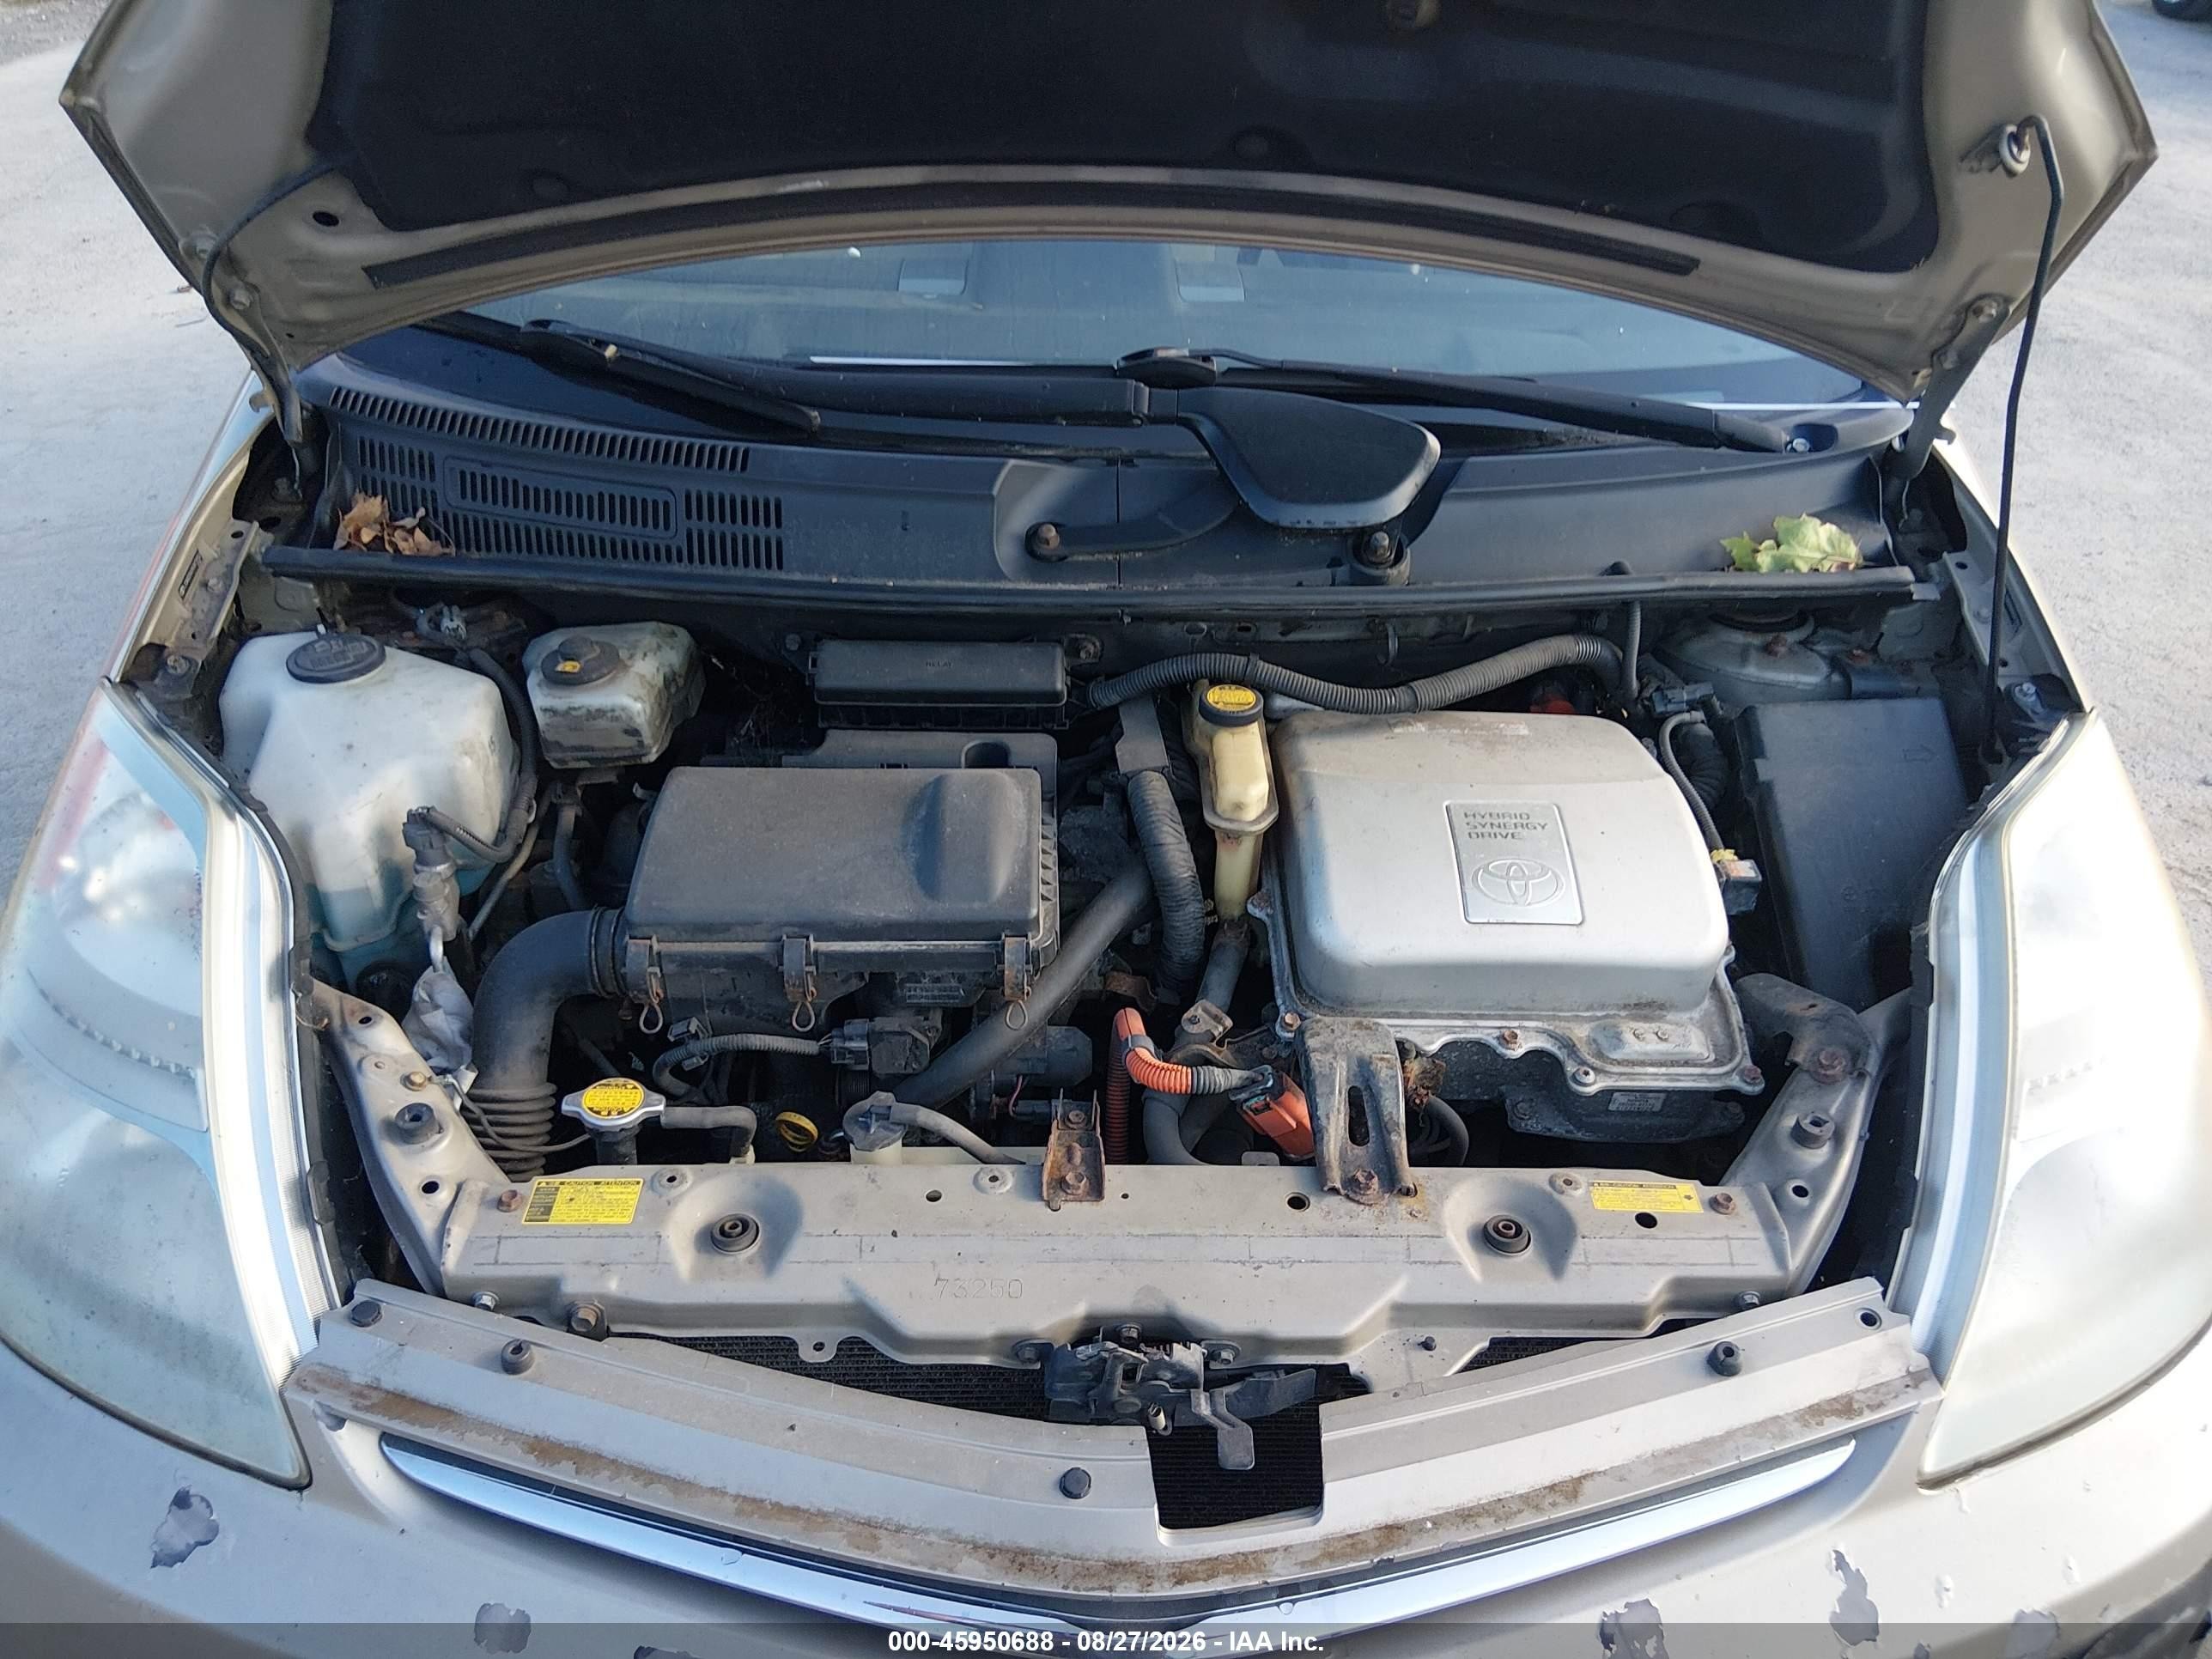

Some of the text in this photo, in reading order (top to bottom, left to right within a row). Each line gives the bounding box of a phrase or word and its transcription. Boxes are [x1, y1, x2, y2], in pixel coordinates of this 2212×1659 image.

[1464, 811, 1530, 821] HYBRID
[1466, 822, 1548, 830] SYNERGY
[1468, 831, 1523, 840] DRIVE
[933, 1277, 1024, 1299] 73250
